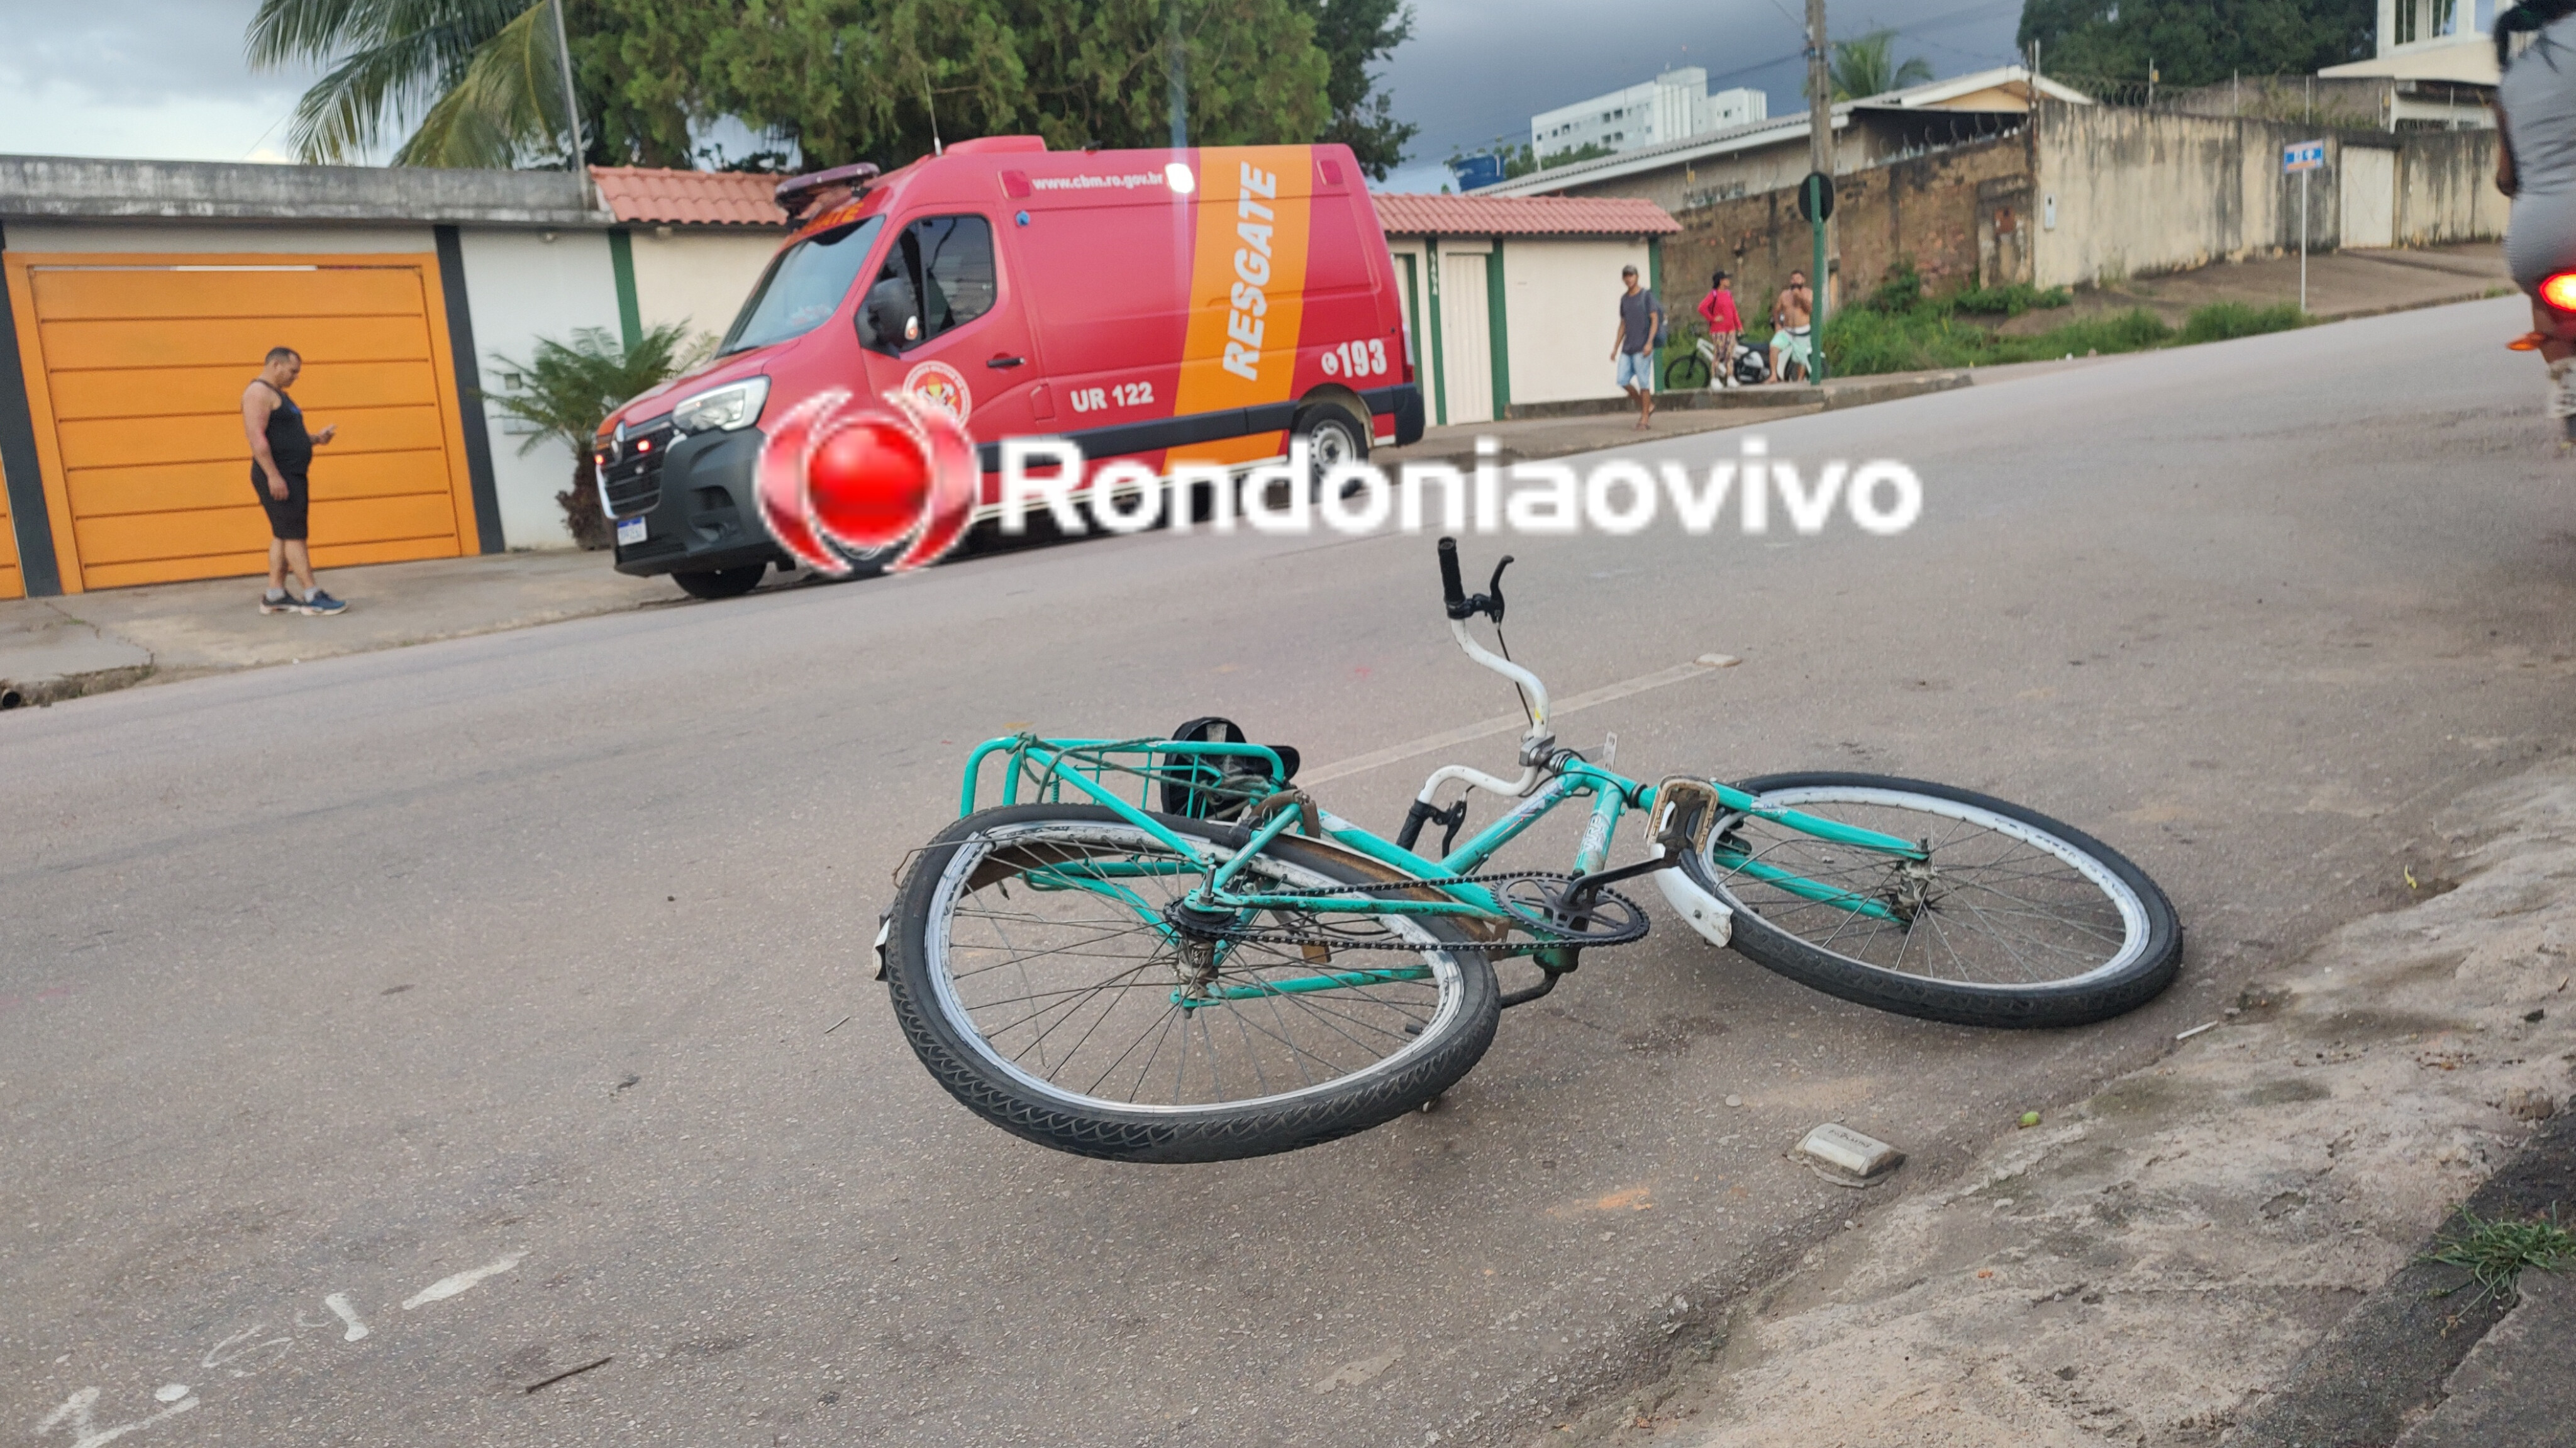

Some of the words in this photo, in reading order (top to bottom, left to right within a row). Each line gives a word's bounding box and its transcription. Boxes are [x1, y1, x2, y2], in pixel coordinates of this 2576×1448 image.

[1032, 170, 1163, 190] www.cbm.ro.gov.br
[1223, 161, 1277, 381] RESGATE
[1336, 338, 1387, 379] 193
[1070, 387, 1108, 413] UR
[1112, 381, 1155, 407] 122
